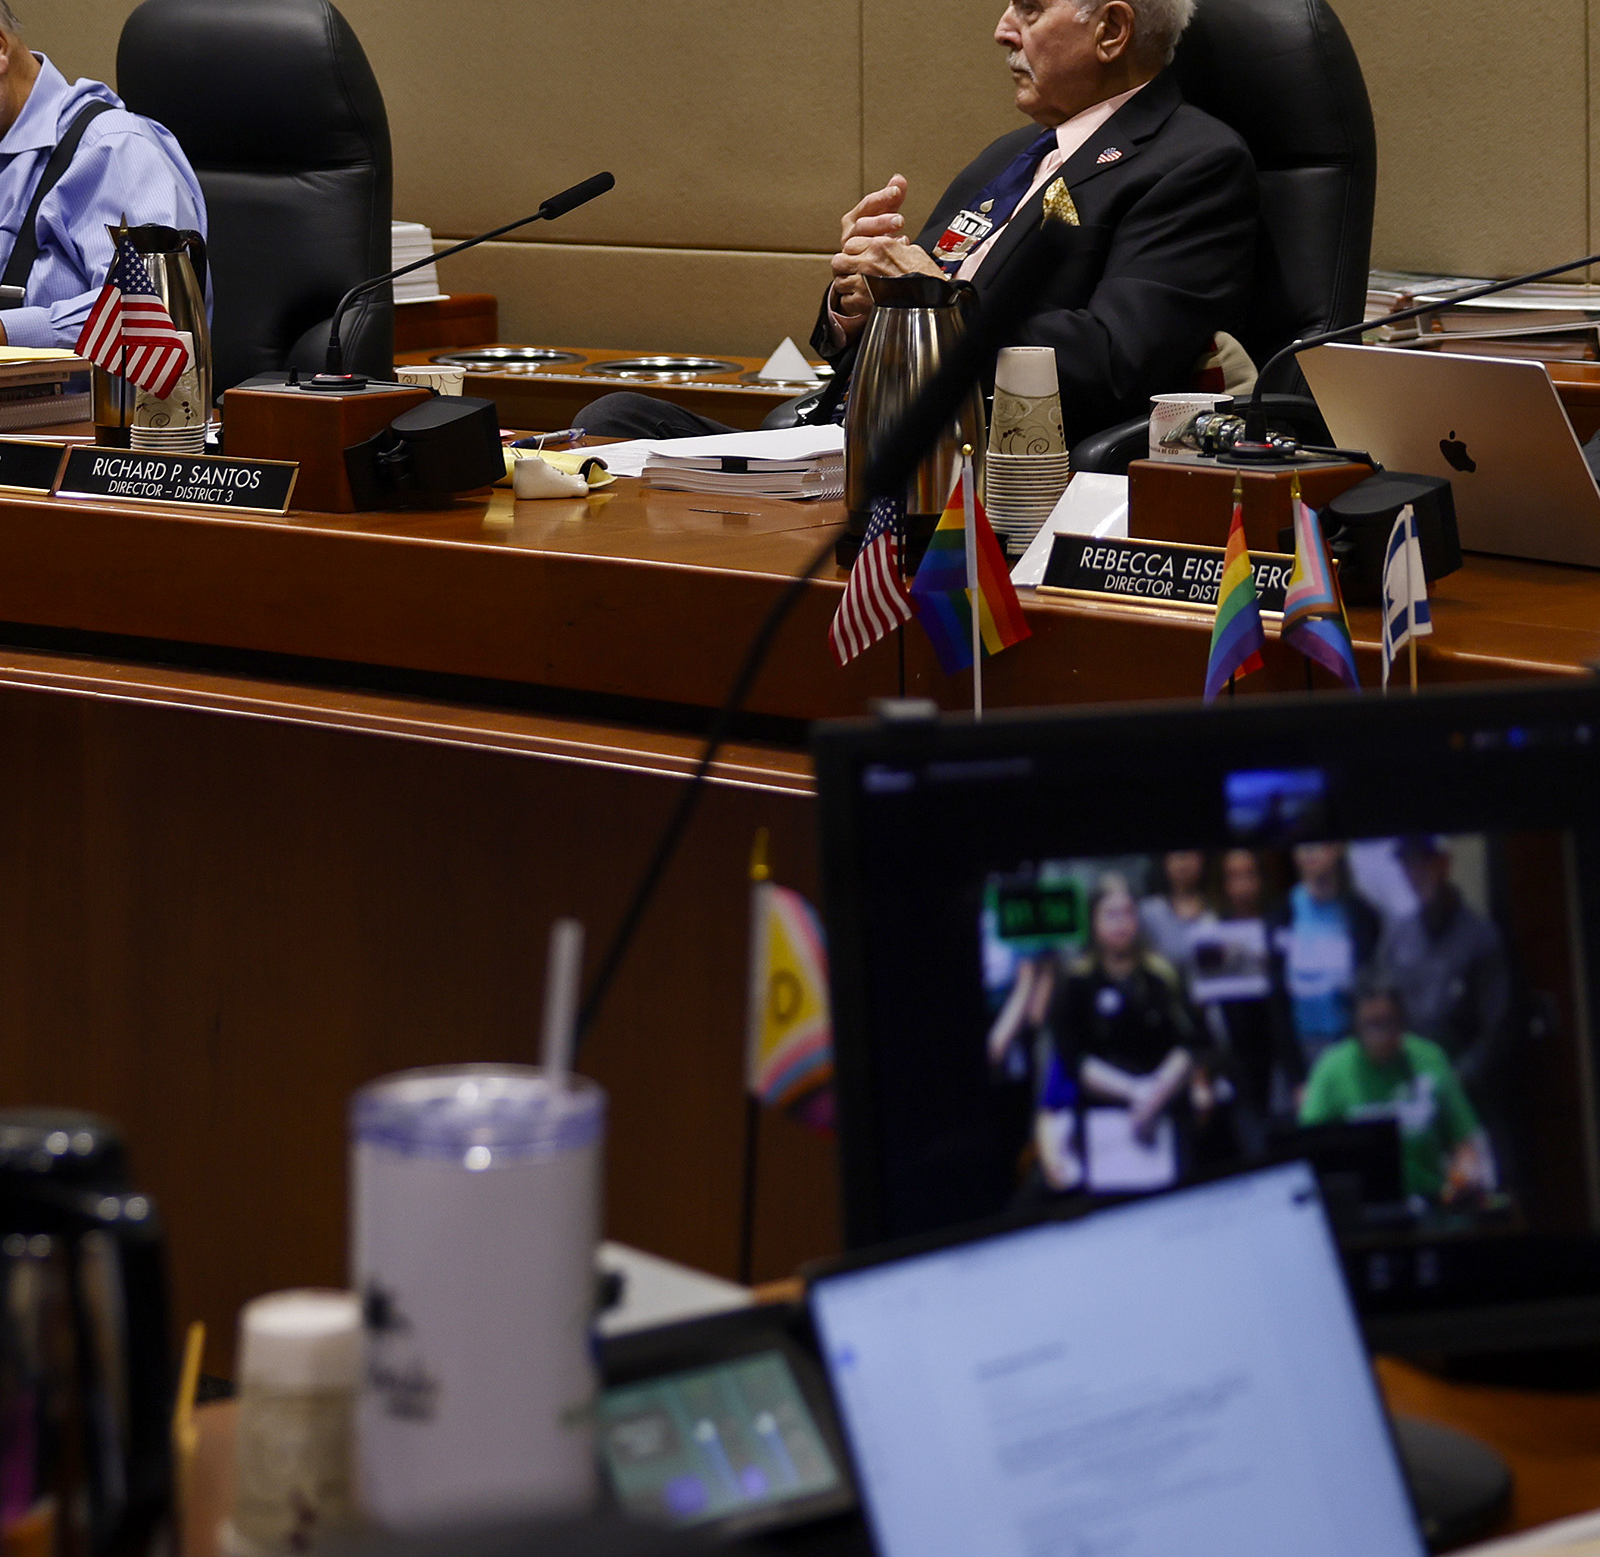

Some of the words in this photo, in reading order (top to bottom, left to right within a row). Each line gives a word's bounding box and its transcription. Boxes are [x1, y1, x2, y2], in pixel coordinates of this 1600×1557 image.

[92, 456, 168, 482] RICHARD
[169, 462, 182, 484] P.
[188, 465, 263, 490] SANTOS
[107, 479, 164, 497] DIRECTOR
[174, 485, 224, 503] DISTRICT
[224, 489, 234, 503] 3
[1078, 545, 1175, 579] REBECCA
[1103, 573, 1173, 597] DIRECTOR
